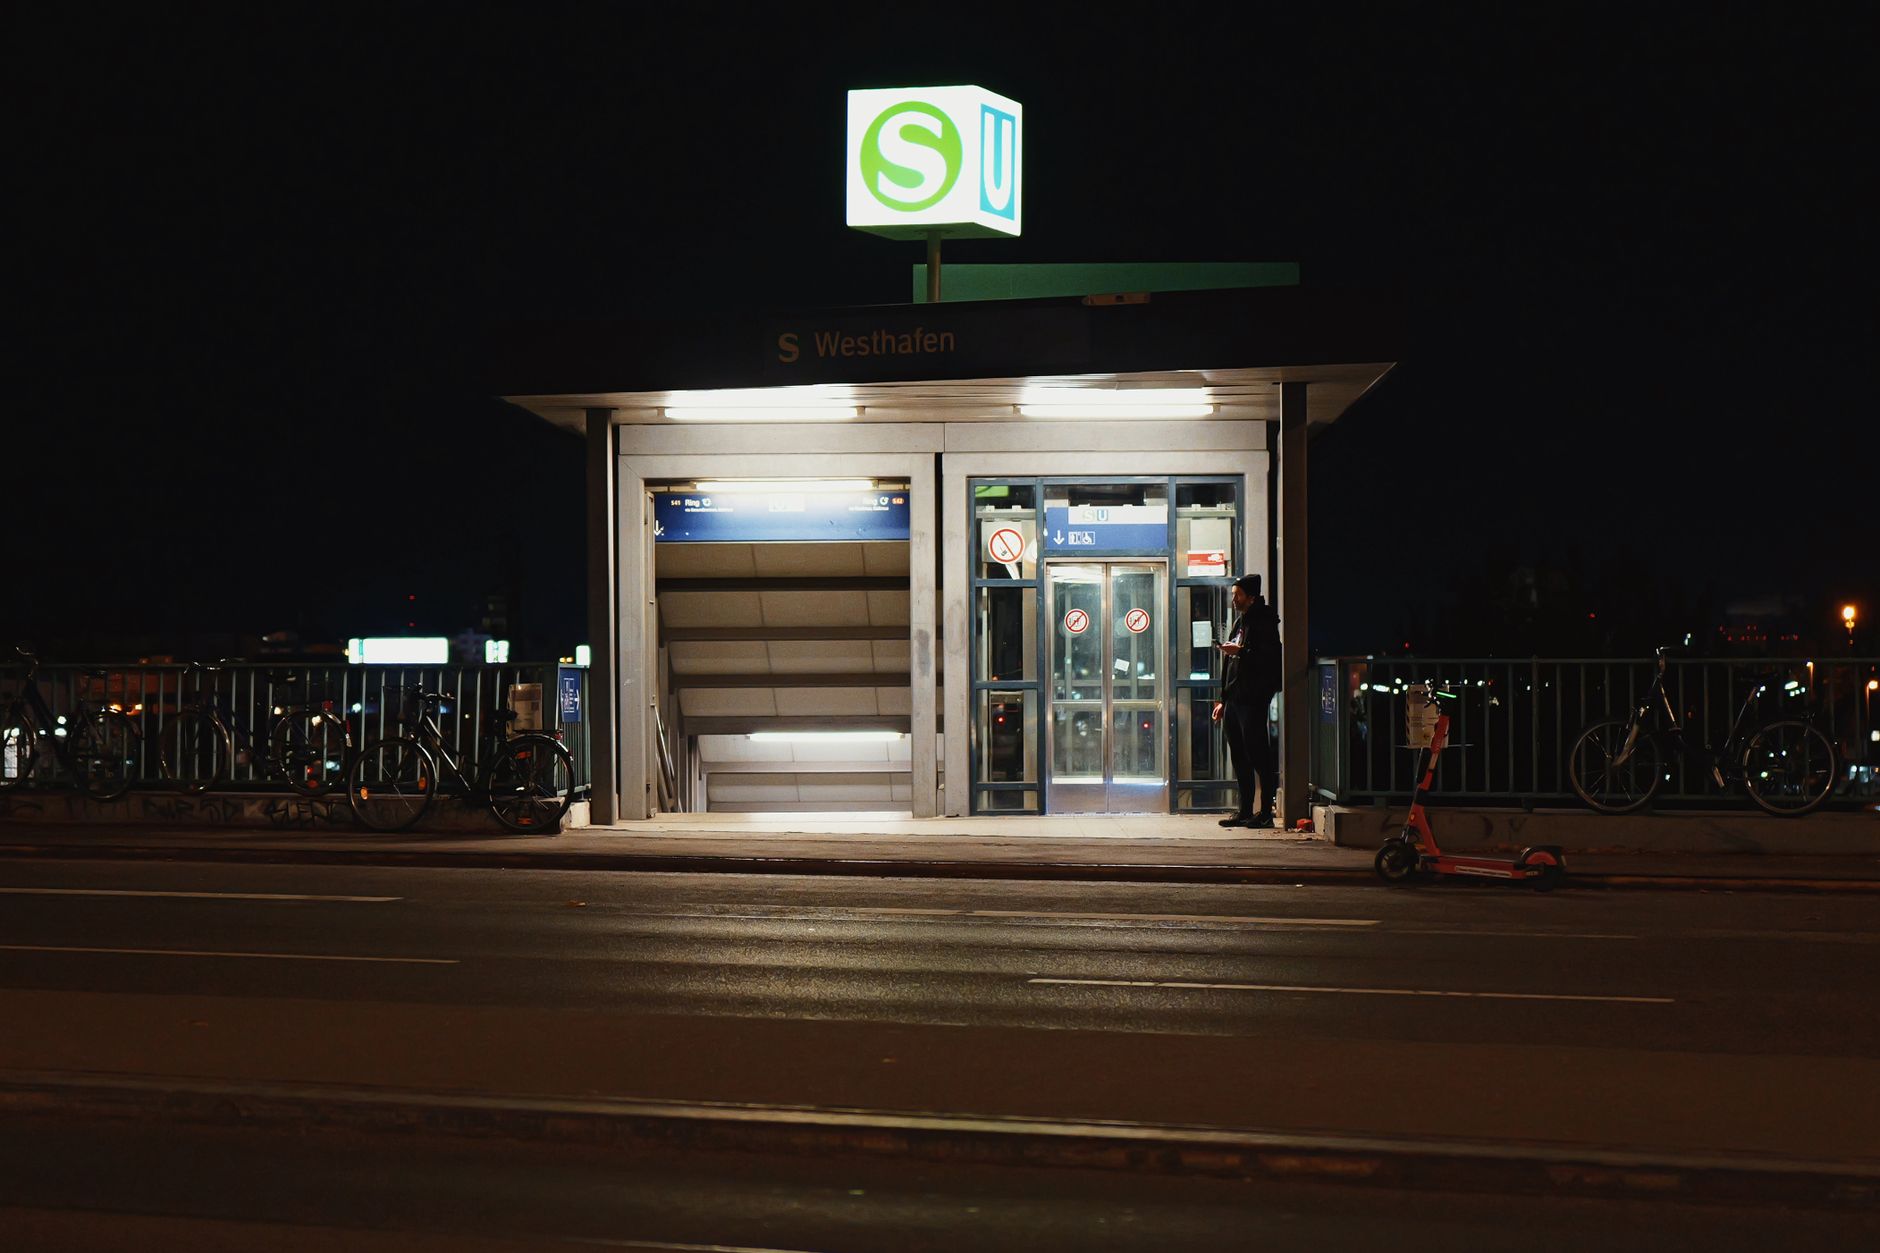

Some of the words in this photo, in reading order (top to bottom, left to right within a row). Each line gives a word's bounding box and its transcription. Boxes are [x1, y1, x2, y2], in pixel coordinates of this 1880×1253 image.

[877, 110, 947, 203] S
[983, 111, 1012, 211] U
[777, 332, 800, 363] S
[814, 327, 956, 358] Westhafen
[685, 499, 700, 507] Ring
[1098, 509, 1108, 521] U
